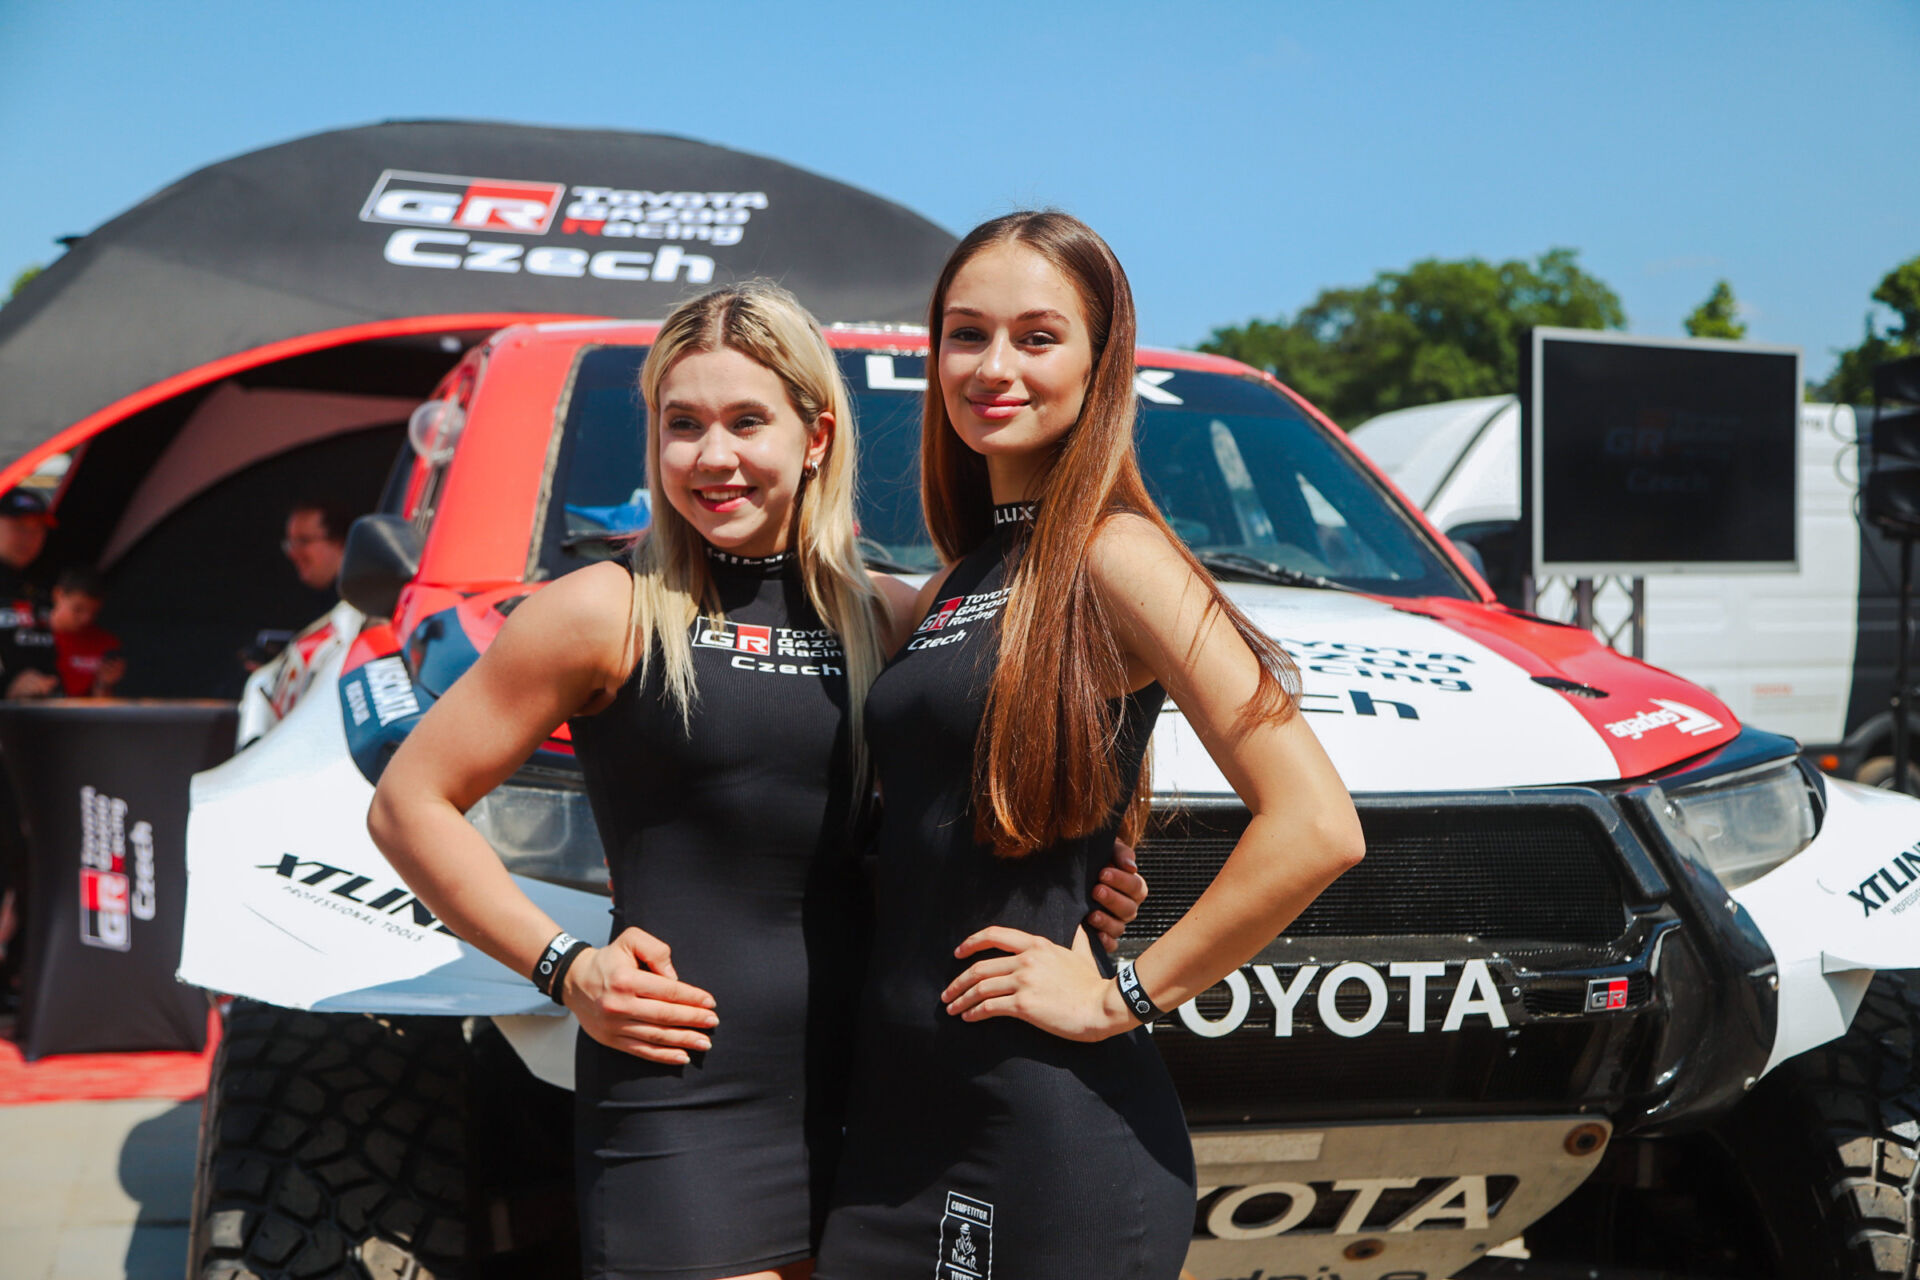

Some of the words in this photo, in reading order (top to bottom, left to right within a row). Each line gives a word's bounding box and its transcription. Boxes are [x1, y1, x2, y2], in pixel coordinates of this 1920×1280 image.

[571, 186, 768, 209] TOYOTA
[374, 188, 549, 231] GR
[566, 201, 751, 225] GAZOO
[561, 217, 744, 246] Racing
[384, 227, 717, 285] Czech
[964, 587, 1013, 605] TOYOT
[917, 609, 955, 632] GR
[946, 608, 998, 627] Racing
[700, 629, 769, 653] GR
[776, 628, 832, 640] TOYO
[777, 638, 838, 648] GAZO
[907, 629, 967, 651] Czech
[778, 647, 842, 658] Racin
[1270, 638, 1476, 664] YOTA
[731, 655, 842, 676] Czech
[1305, 664, 1473, 692] cing
[1847, 841, 1920, 918] XTLIN
[254, 853, 465, 940] XTLIN
[1150, 958, 1509, 1038] OYOTA
[1591, 990, 1625, 1008] GR
[951, 1200, 988, 1221] COMPETITOR
